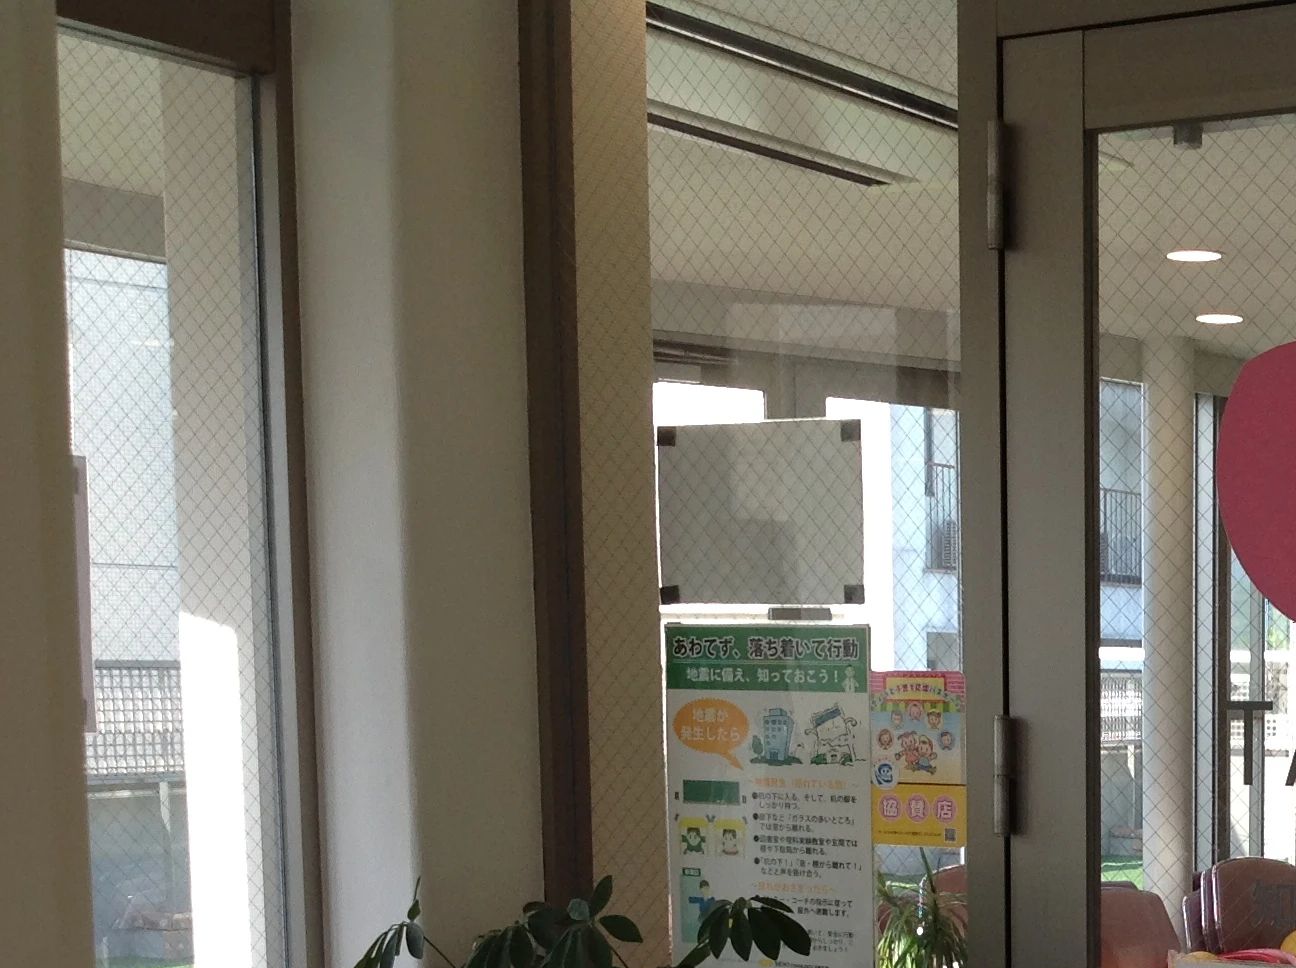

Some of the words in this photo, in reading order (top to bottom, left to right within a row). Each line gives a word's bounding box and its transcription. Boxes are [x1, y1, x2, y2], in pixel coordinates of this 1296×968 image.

[673, 636, 859, 660] あわてず、落ち着いて行動
